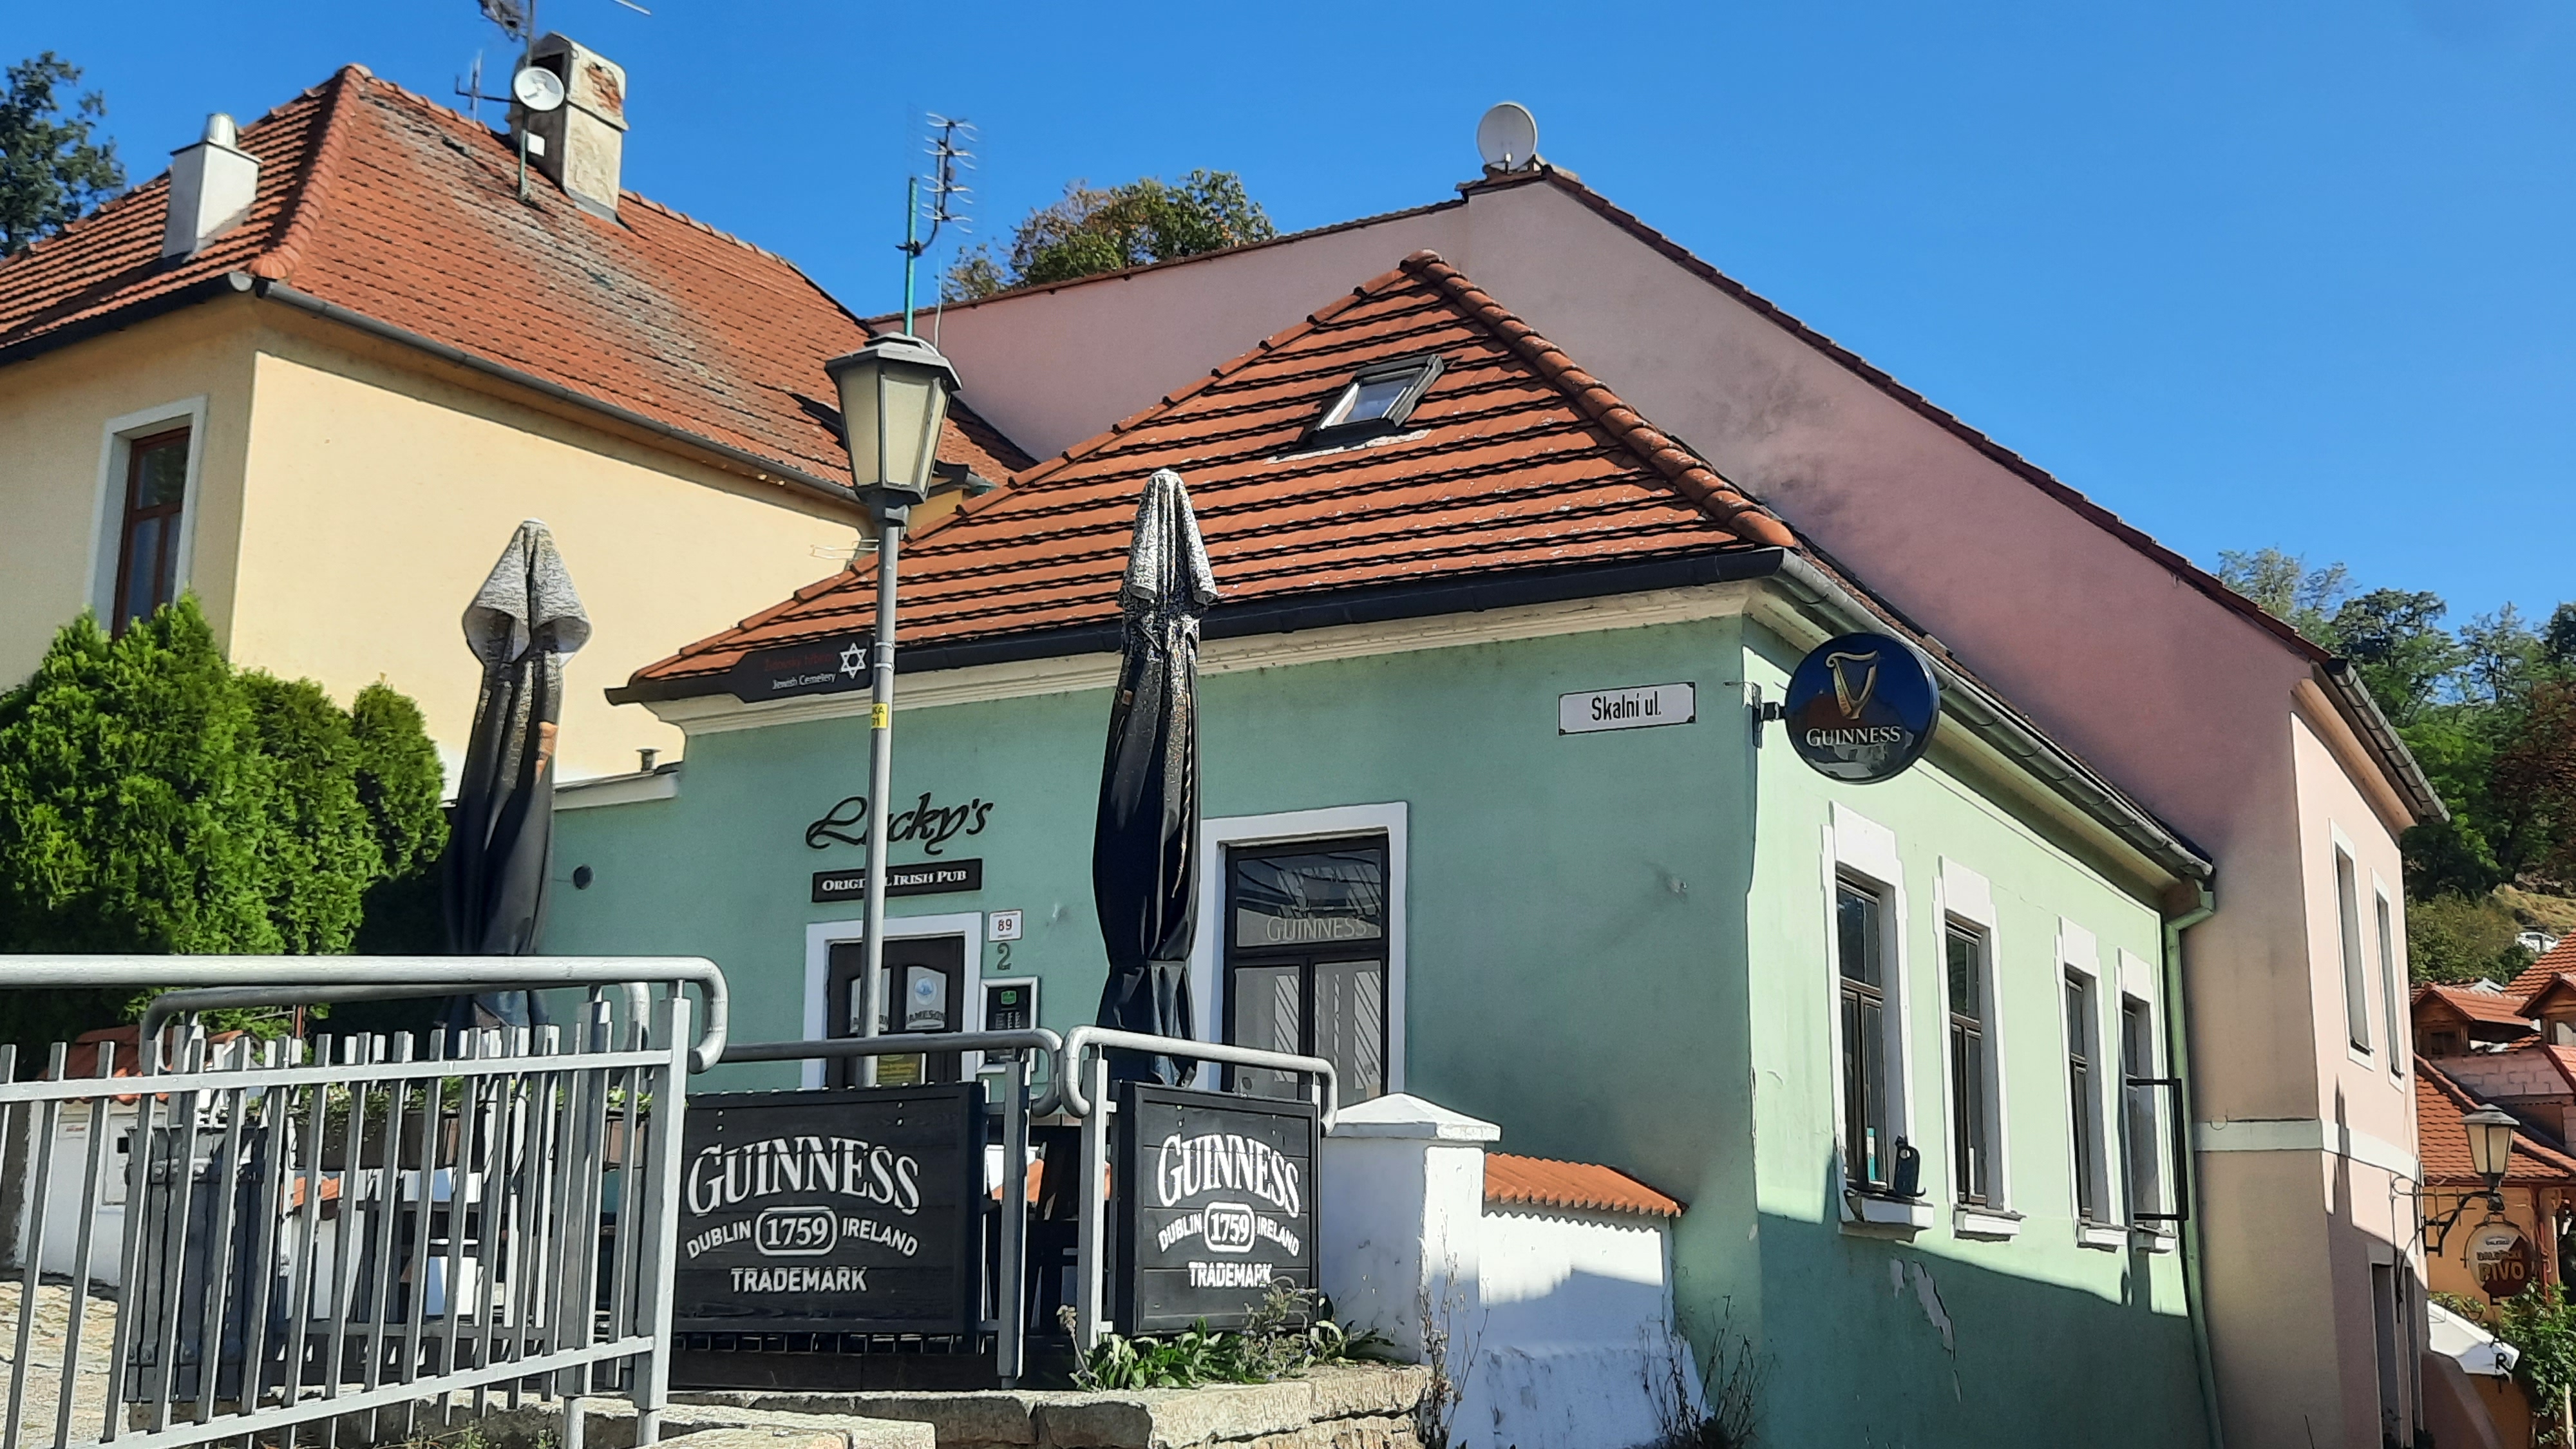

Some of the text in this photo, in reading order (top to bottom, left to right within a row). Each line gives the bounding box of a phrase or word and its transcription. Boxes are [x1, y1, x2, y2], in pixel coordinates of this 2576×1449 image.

[799, 673, 837, 686] Cemetery
[1591, 692, 1640, 721] Skalní
[1806, 726, 1901, 746] GUINNESS
[805, 791, 994, 855] Lcky's
[822, 870, 967, 891] ORIGIL IRISH PUB
[998, 918, 1012, 931] 89
[1266, 916, 1368, 942] GUINNESS
[997, 942, 1012, 971] 2
[687, 1135, 920, 1217] GUINNESS
[1157, 1133, 1300, 1218] GUINNESS
[686, 1217, 920, 1260] DUBLIN 1759 IRELAND
[1157, 1213, 1300, 1256] DUBLIN 1759 IRELAND
[730, 1266, 868, 1293] TRADEMARK
[1188, 1261, 1273, 1289] TRADEMARK
[2478, 1262, 2525, 1282] PIVO
